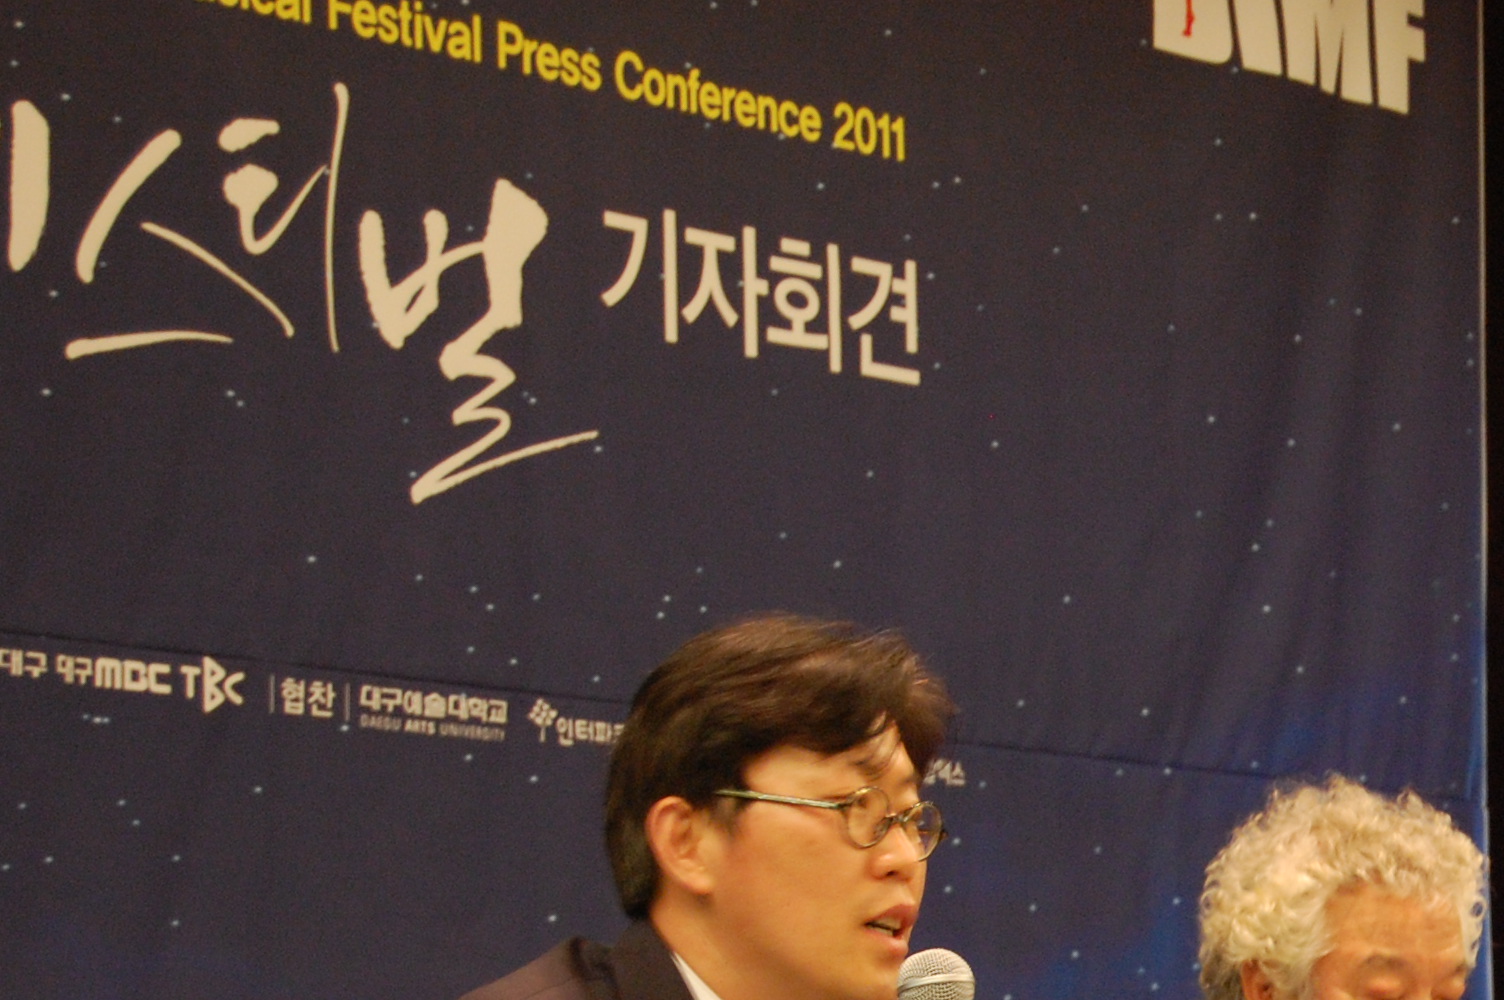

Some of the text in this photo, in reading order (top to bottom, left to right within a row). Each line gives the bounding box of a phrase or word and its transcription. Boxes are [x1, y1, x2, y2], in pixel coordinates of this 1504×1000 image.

[328, 0, 906, 162] Festival Press Conference 2011
[8, 82, 921, 505] 스티벌 기자회견
[180, 656, 245, 713] TBC
[281, 677, 336, 718] 협찬
[360, 685, 508, 723] 대구예술대학교
[404, 718, 436, 736] ARTS
